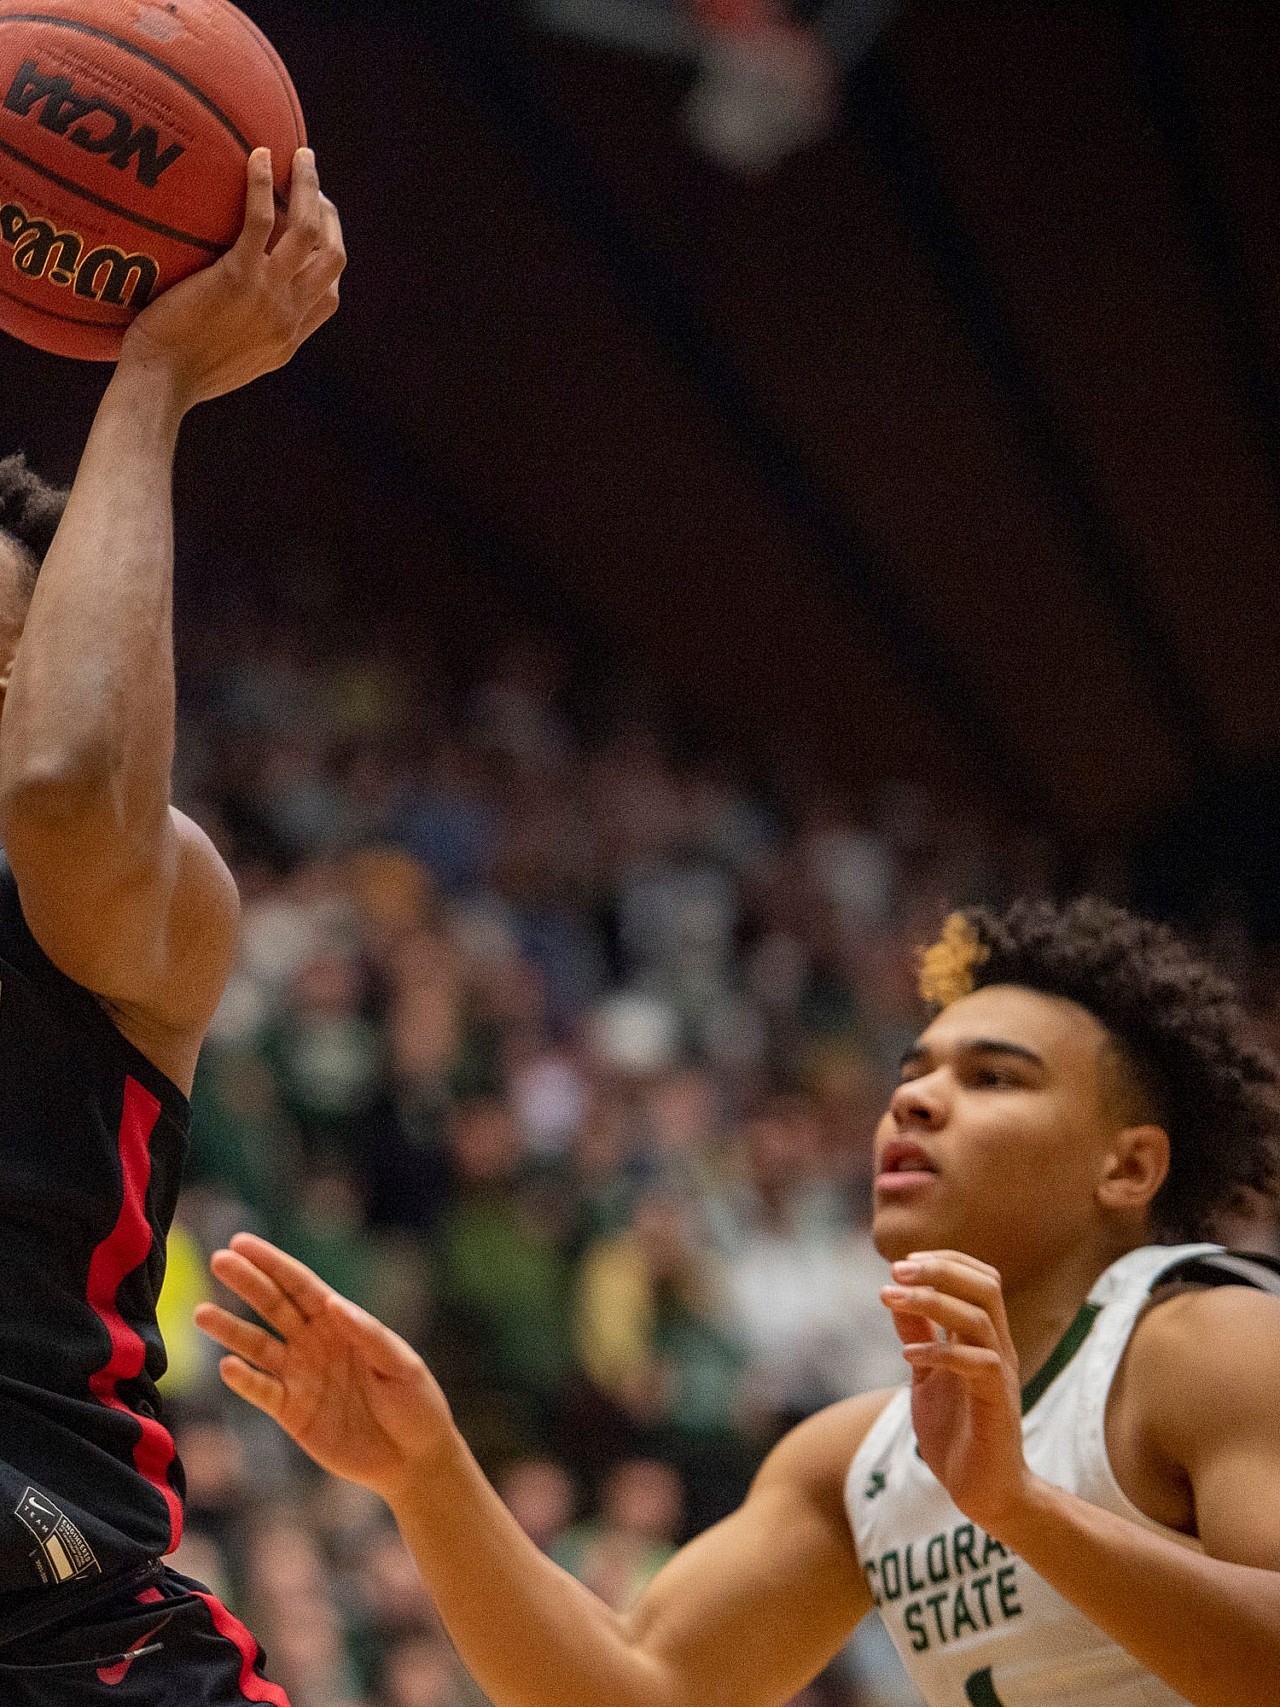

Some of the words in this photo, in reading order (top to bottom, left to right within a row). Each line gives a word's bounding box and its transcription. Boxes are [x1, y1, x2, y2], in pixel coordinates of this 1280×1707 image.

[3, 59, 186, 188] NCAA
[23, 1504, 49, 1534] TEAM
[864, 1522, 1008, 1608] COLORA
[904, 1565, 1023, 1652] STATE
